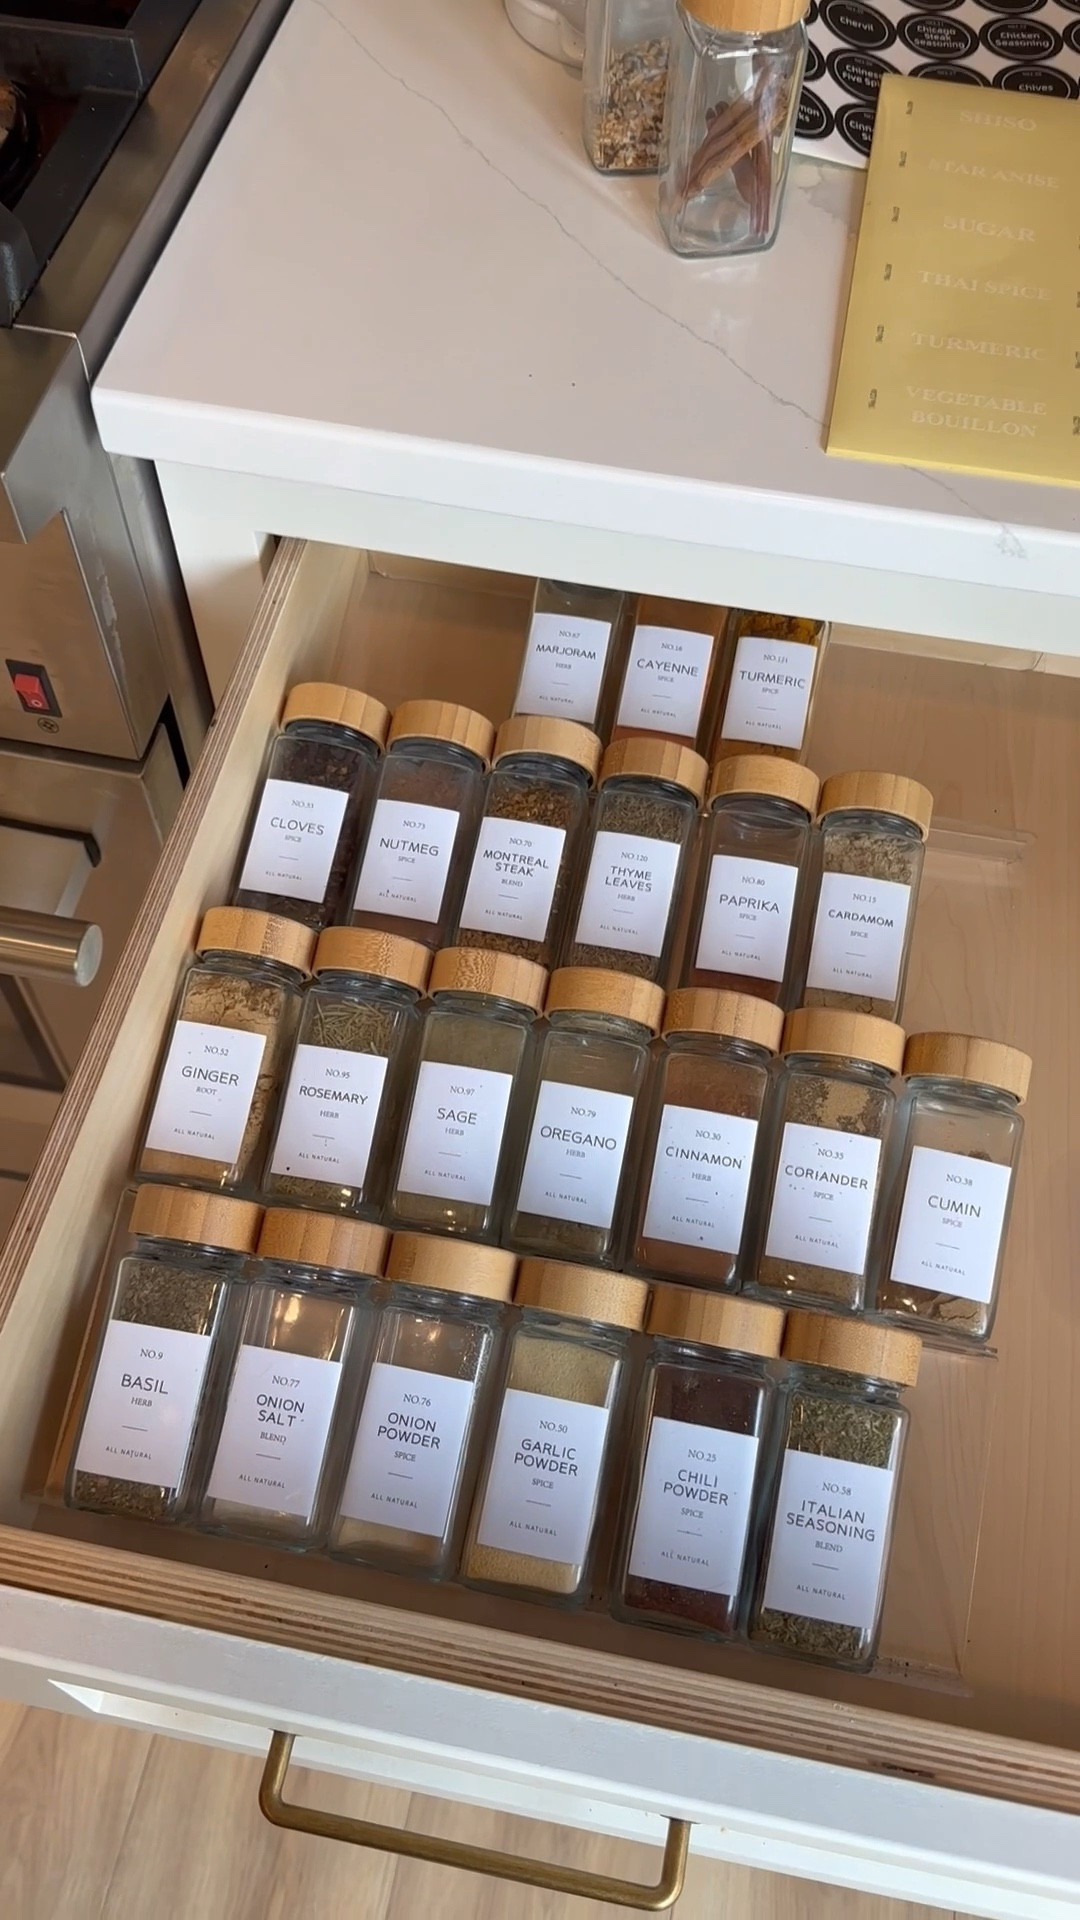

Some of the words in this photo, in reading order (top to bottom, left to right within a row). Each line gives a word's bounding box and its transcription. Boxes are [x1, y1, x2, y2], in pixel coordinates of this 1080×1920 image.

[839, 16, 874, 32] Chervil
[917, 25, 956, 36] Chicago
[924, 33, 951, 41] Steak
[1000, 31, 1040, 39] Chicken
[914, 38, 965, 49] Seasoning
[995, 39, 1050, 48] Seasoning
[845, 64, 882, 79] Chines
[1018, 84, 1054, 92] Chives
[992, 169, 1061, 190] ANISE
[943, 215, 1036, 243] SUGAR
[917, 270, 977, 292] THAI
[983, 279, 1053, 301] SPICE
[911, 331, 1047, 361] TURMERIC
[905, 385, 1048, 416] VEGETABLE
[911, 410, 1037, 438] BOUILLON
[535, 644, 597, 660] MARJORAM
[636, 658, 699, 677] CAYENNE
[739, 670, 806, 689] TURMERIC
[270, 816, 325, 836] CLOVES
[379, 837, 439, 857] NUTMEG
[483, 849, 549, 870] MONTREAL
[494, 862, 535, 878] STEAK
[610, 865, 652, 881] THYME
[604, 876, 653, 892] LEAVES
[719, 893, 780, 914] PAPRIKA
[828, 909, 894, 928] CARDAMOM
[204, 1045, 229, 1056] NO.52
[181, 1065, 240, 1087] GINGER
[325, 1068, 351, 1079] NO.95
[196, 1086, 218, 1095] ROOT
[299, 1085, 369, 1105] ROSEMARY
[450, 1085, 475, 1096] NO.97
[319, 1110, 339, 1119] HERB
[436, 1107, 478, 1126] SAGE
[570, 1106, 597, 1118] NO.79
[187, 1130, 215, 1140] NATURAL
[445, 1127, 464, 1136] HERB
[540, 1125, 618, 1150] OREGANO
[695, 1129, 722, 1142] NO.30
[311, 1154, 340, 1163] NATURAL
[566, 1148, 586, 1158] HERB
[665, 1146, 743, 1170] CINNAMON
[817, 1148, 844, 1160] NO.35
[438, 1172, 467, 1181] NATURAL
[691, 1172, 712, 1182] HERB
[784, 1164, 869, 1190] CORIANDER
[946, 1173, 973, 1187] NO.38
[559, 1194, 587, 1204] NATURAL
[813, 1190, 834, 1201] SPICE
[927, 1195, 981, 1218] CUMIN
[685, 1218, 714, 1228] NATURAL
[942, 1217, 963, 1228] SPICE
[809, 1237, 839, 1248] NATURAL
[921, 1260, 933, 1268] ALL
[935, 1264, 965, 1275] NATURAL
[140, 1348, 164, 1360] NO.9
[120, 1373, 169, 1396] BASIL
[271, 1375, 301, 1388] NO.77
[130, 1396, 153, 1407] HERB
[256, 1393, 305, 1414] ONION
[403, 1393, 432, 1407] NO.76
[257, 1409, 296, 1427] SALT
[387, 1412, 437, 1433] ONION
[539, 1420, 568, 1434] NO.50
[260, 1431, 287, 1444] BLEND
[377, 1425, 441, 1450] POWDER
[105, 1445, 118, 1454] ALL
[120, 1448, 152, 1460] NATURAL
[394, 1450, 416, 1463] SPICE
[521, 1438, 577, 1461] GARLIC
[688, 1449, 717, 1463] NO.25
[514, 1451, 578, 1477] POWDER
[239, 1474, 253, 1483] ALL
[254, 1476, 286, 1489] NATURAL
[531, 1477, 554, 1490] SPICE
[677, 1468, 719, 1488] CHILI
[663, 1481, 729, 1507] POWDER
[822, 1482, 852, 1496] NO.58
[370, 1492, 384, 1502] ALL
[386, 1495, 418, 1509] NATURAL
[681, 1507, 704, 1519] SPICE
[801, 1499, 865, 1524] ITALIAN
[509, 1521, 522, 1529] ALL
[525, 1524, 557, 1536] NATURAL
[786, 1512, 875, 1542] SEASONING
[815, 1540, 843, 1552] BLEND
[661, 1551, 674, 1559] ALL
[677, 1554, 709, 1566] NATURAL
[796, 1584, 810, 1593] ALL
[812, 1587, 845, 1600] NATURAL
